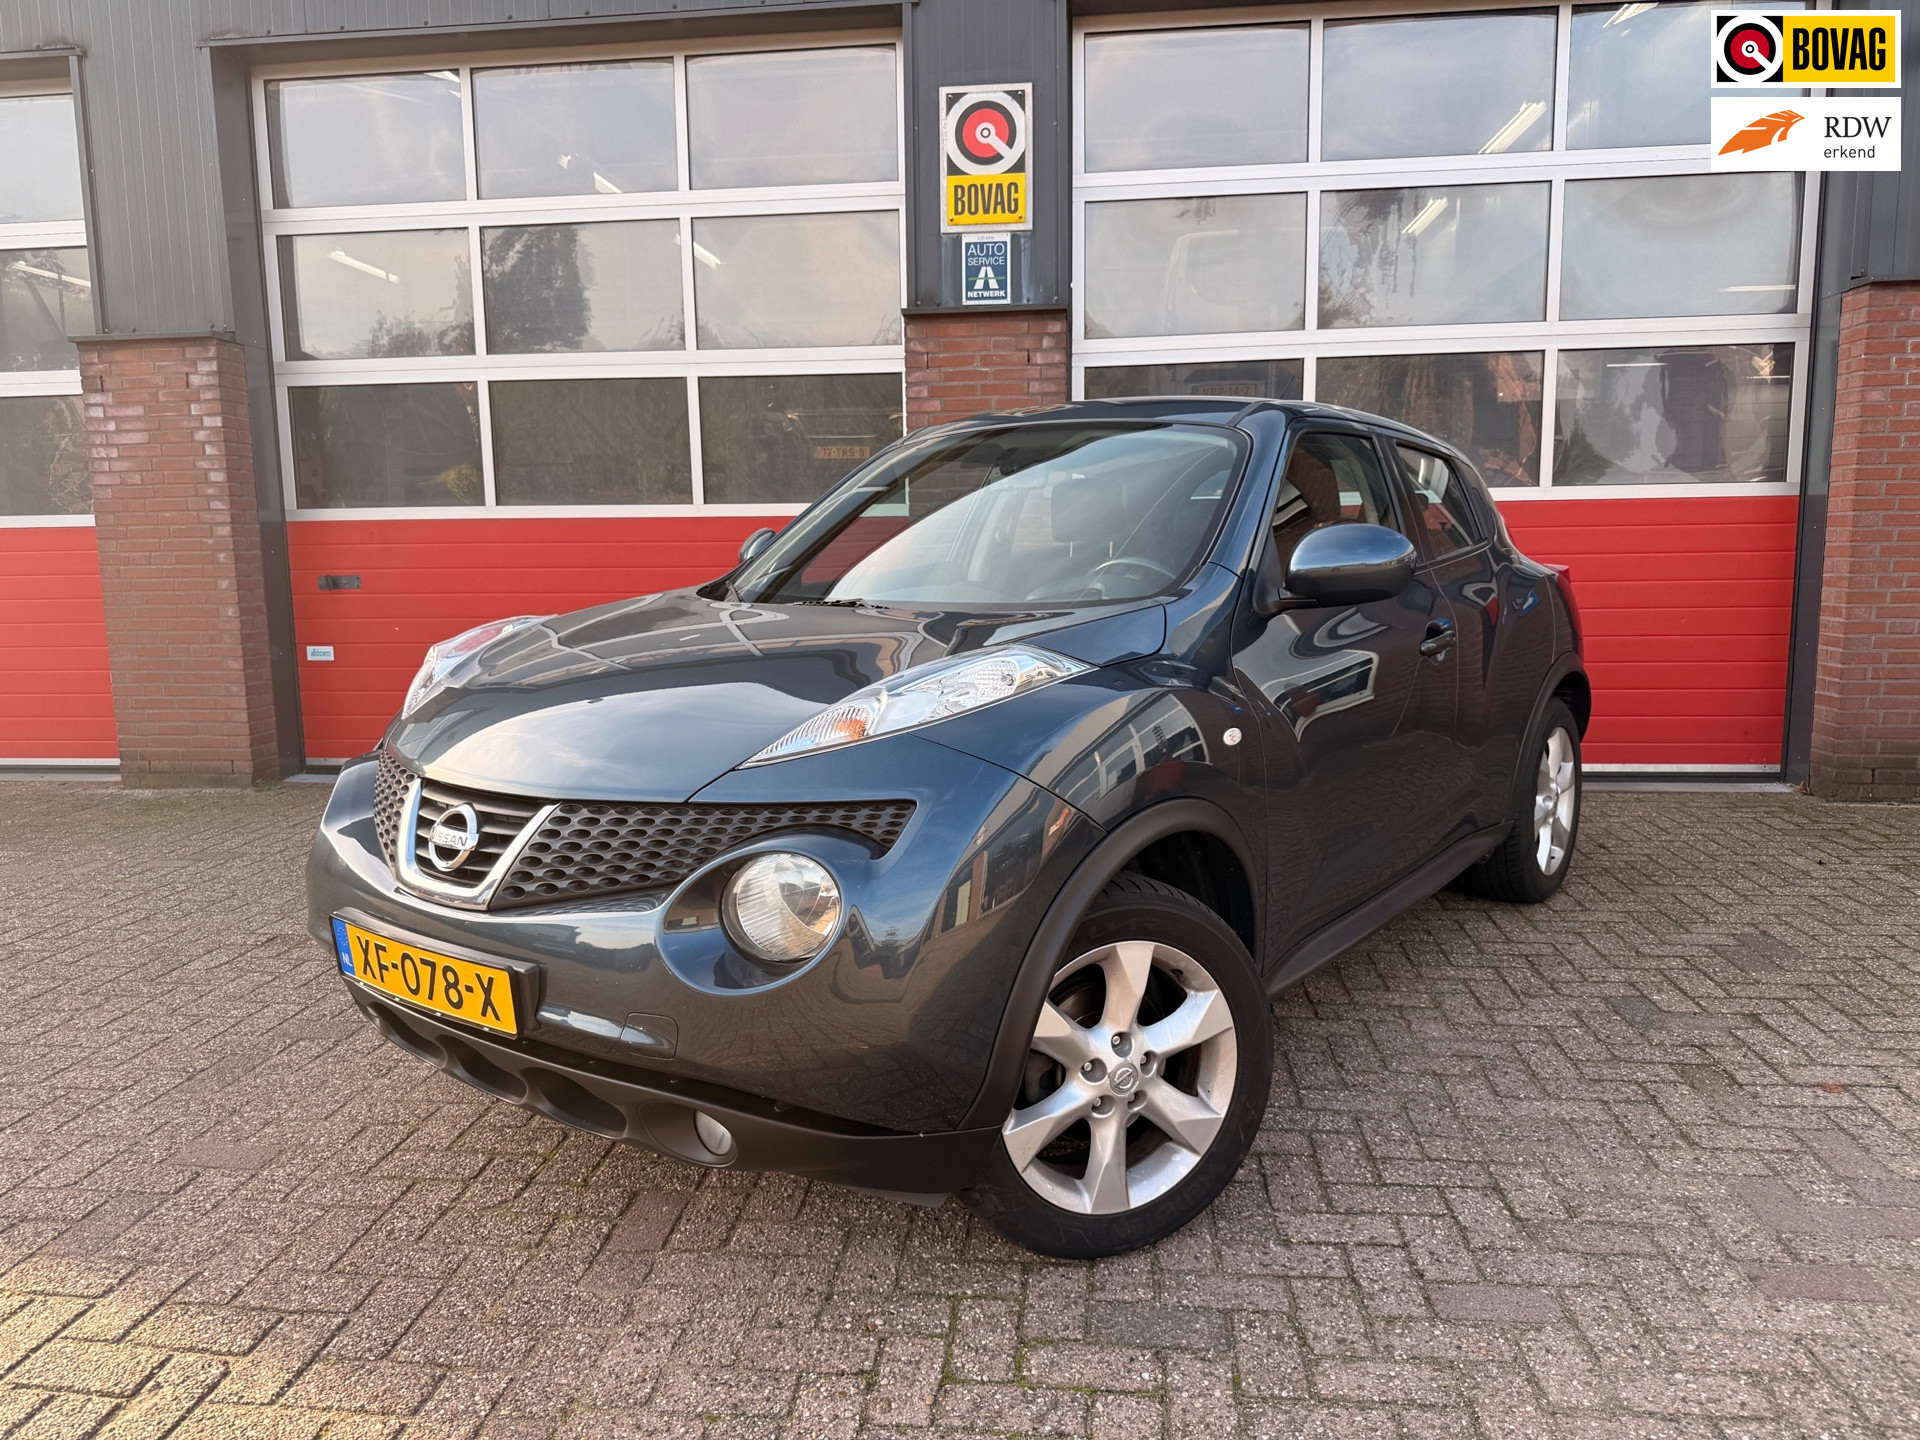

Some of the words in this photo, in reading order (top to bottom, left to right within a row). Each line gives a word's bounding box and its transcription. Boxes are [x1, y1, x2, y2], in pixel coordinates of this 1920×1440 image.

[953, 182, 1019, 216] BOVAG
[967, 243, 1005, 256] AUTO
[967, 256, 1005, 266] SERVICE
[967, 290, 1006, 298] NETWERK
[432, 830, 468, 847] SSAN
[341, 951, 353, 967] NL
[356, 934, 501, 1022] XF-078-X
